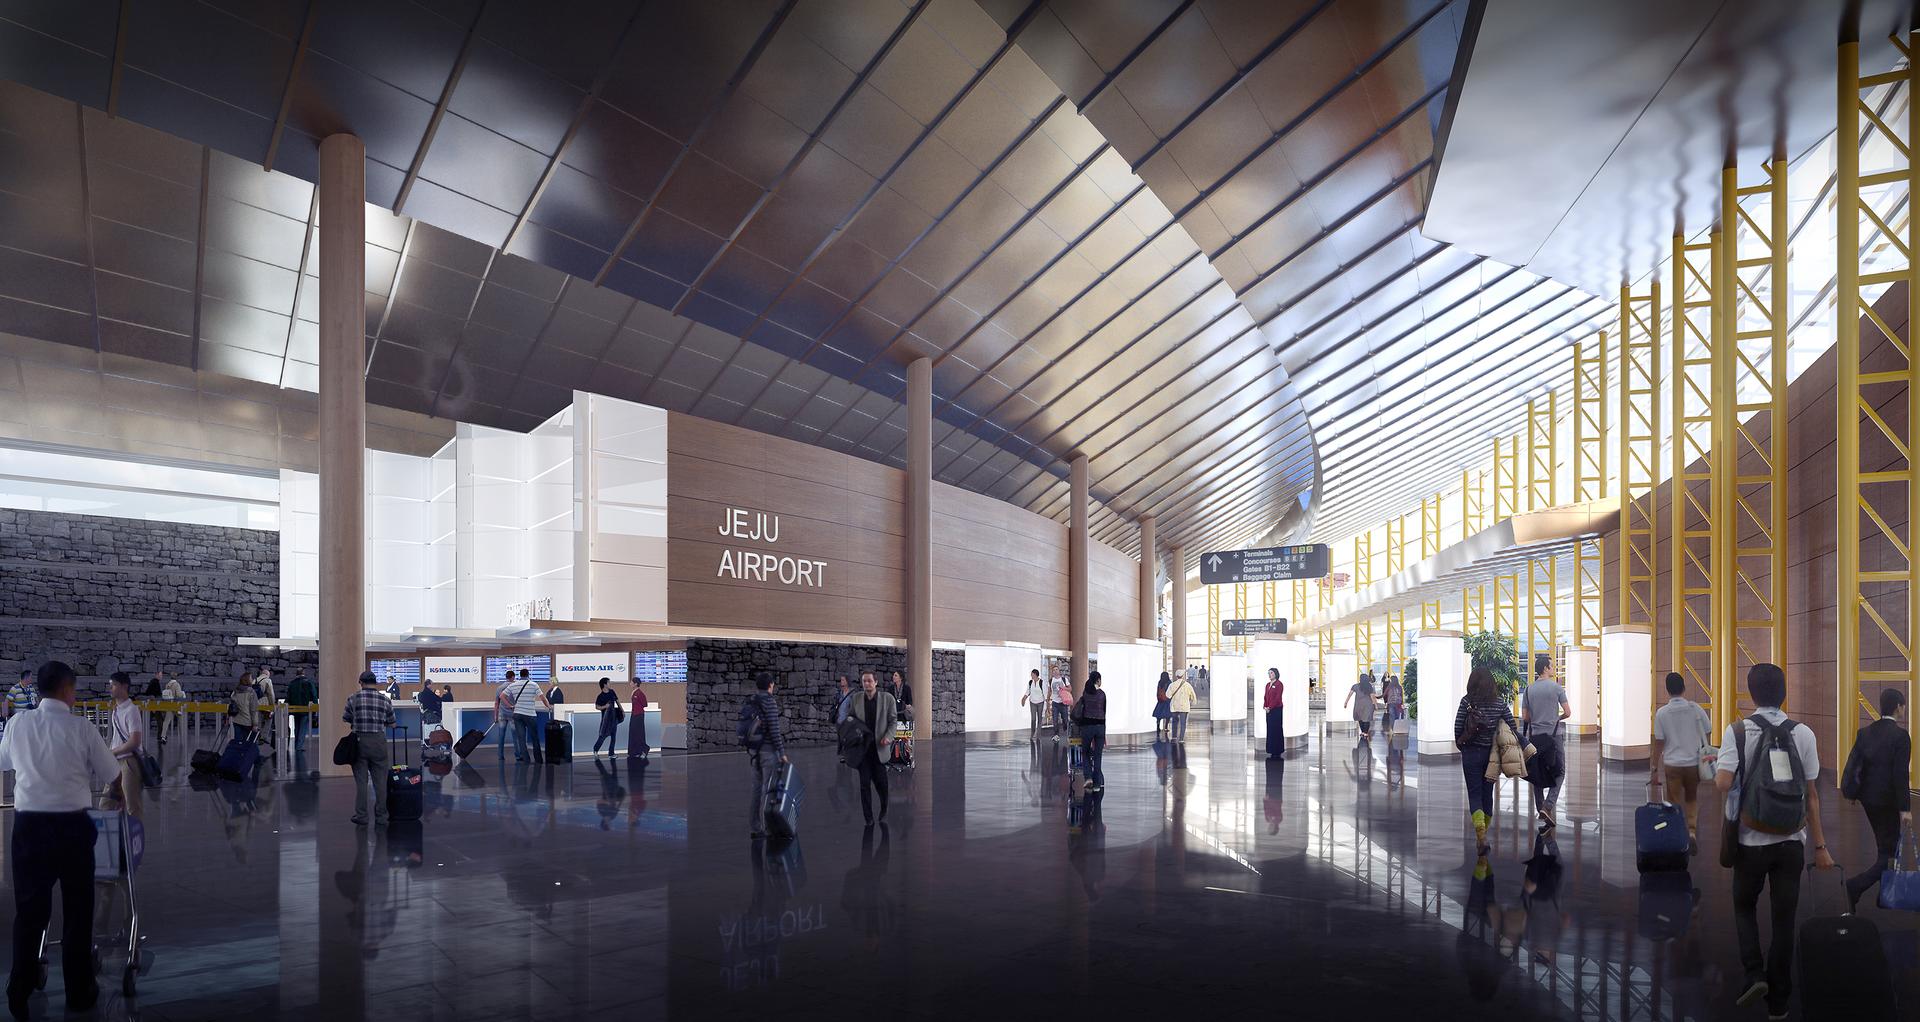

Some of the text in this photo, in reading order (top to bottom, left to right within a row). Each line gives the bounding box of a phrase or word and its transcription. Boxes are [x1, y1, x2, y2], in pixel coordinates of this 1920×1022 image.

[718, 507, 779, 543] JEJU
[1243, 549, 1274, 558] Terminals
[1243, 557, 1281, 566] Concourses
[717, 549, 828, 588] AIRPORT
[1243, 571, 1292, 582] Baggage Claim
[561, 664, 596, 672] KOREAN
